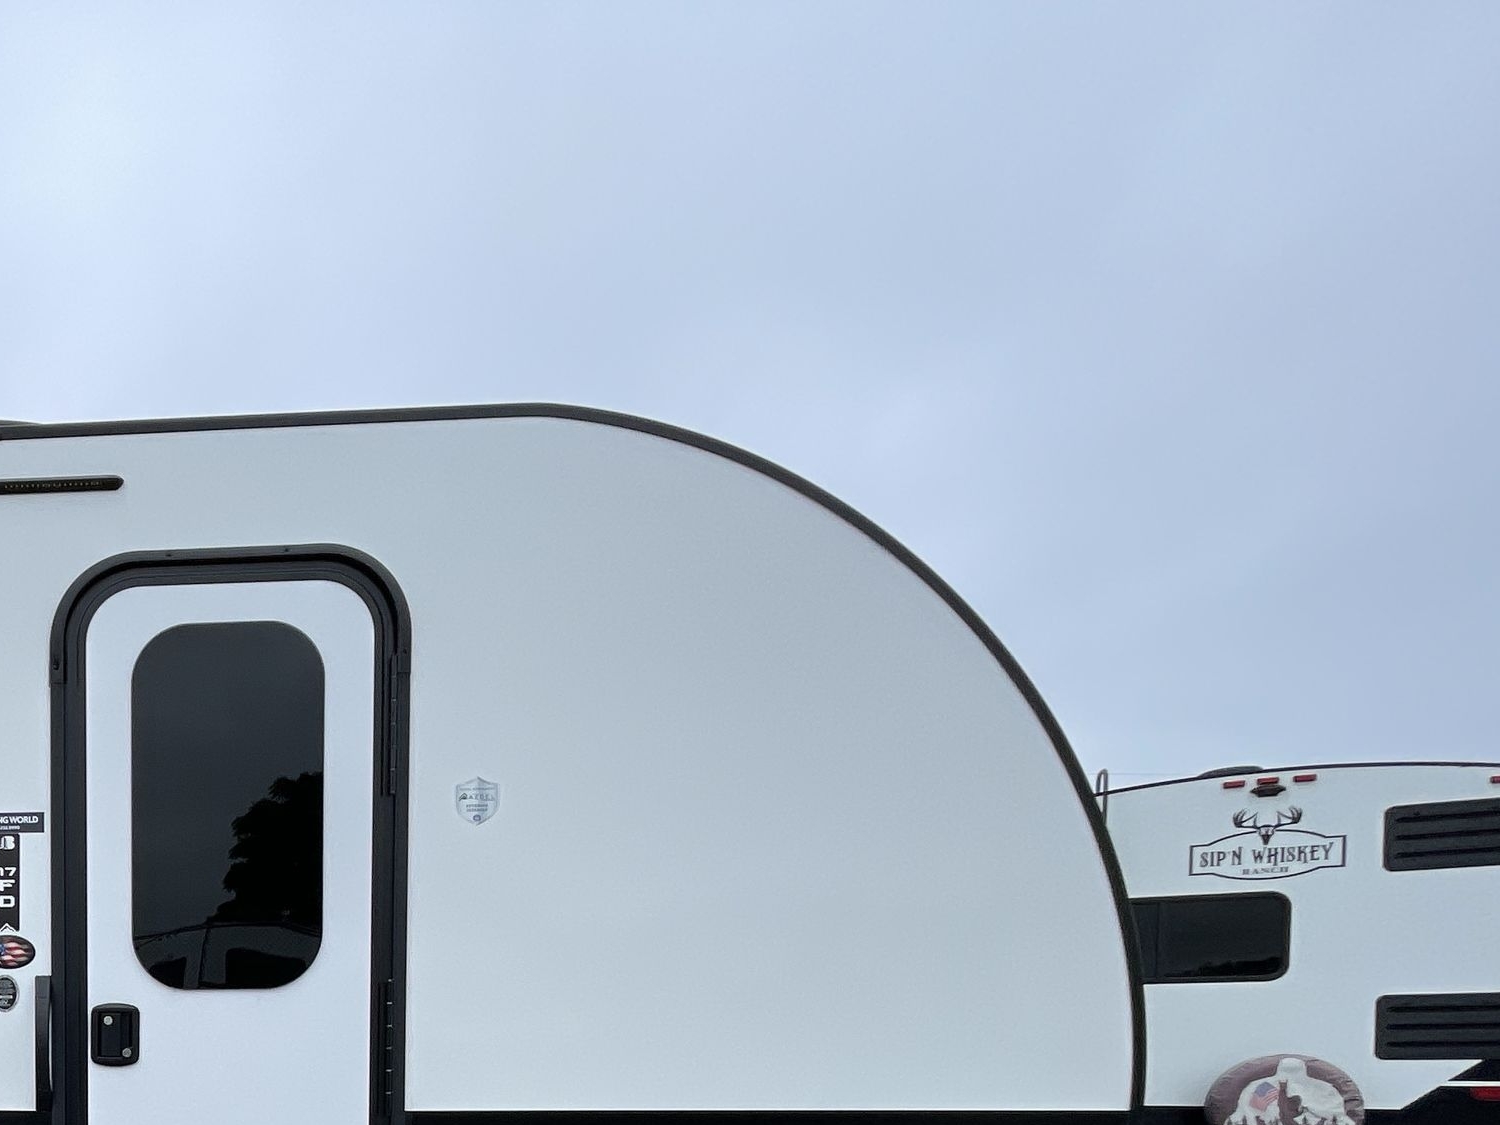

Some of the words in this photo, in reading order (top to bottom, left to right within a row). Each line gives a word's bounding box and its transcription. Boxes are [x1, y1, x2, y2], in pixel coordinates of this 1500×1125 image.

[9, 815, 39, 824] WORLD
[1200, 846, 1243, 868] SIP'N
[1252, 842, 1334, 866] WHISKEY
[1242, 866, 1290, 876] RANCH
